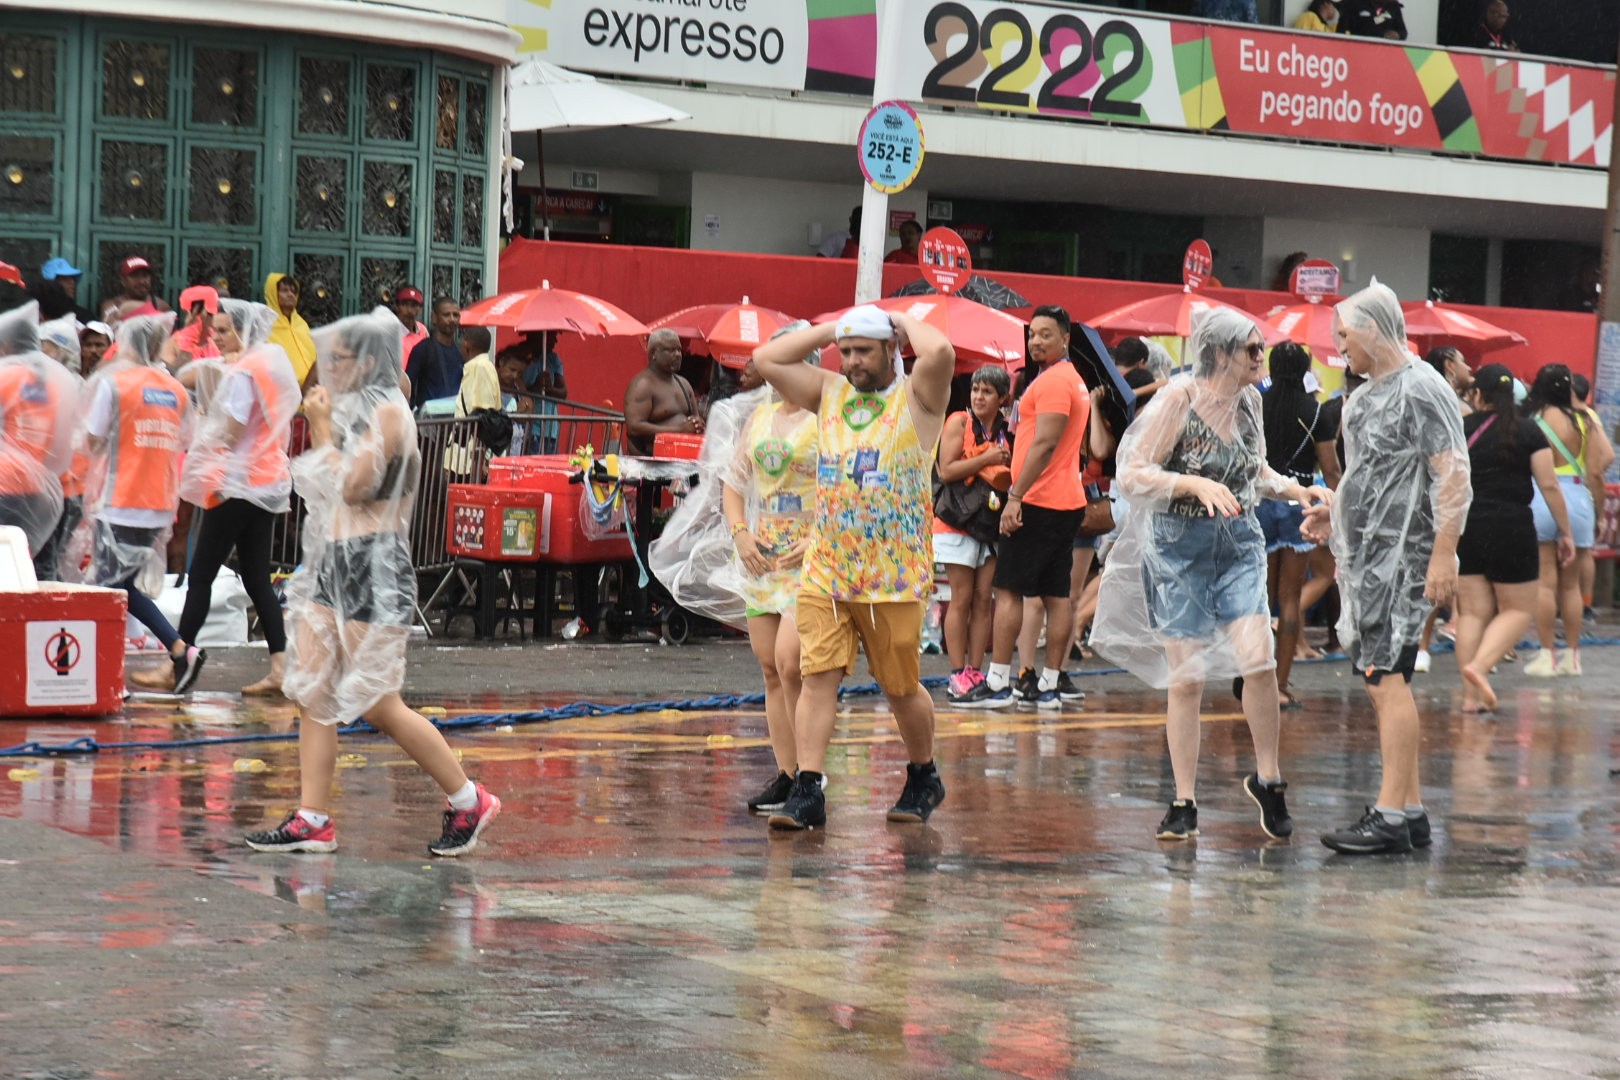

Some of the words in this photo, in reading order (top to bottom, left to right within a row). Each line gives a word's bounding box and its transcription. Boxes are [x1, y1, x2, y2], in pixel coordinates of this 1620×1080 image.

[583, 8, 785, 65] expresso
[921, 2, 1146, 117] 2222
[1239, 38, 1270, 73] Eu
[1277, 43, 1349, 88] chego
[1260, 90, 1363, 127] pegando
[1369, 92, 1424, 136] fogo
[867, 141, 913, 165] 252-E
